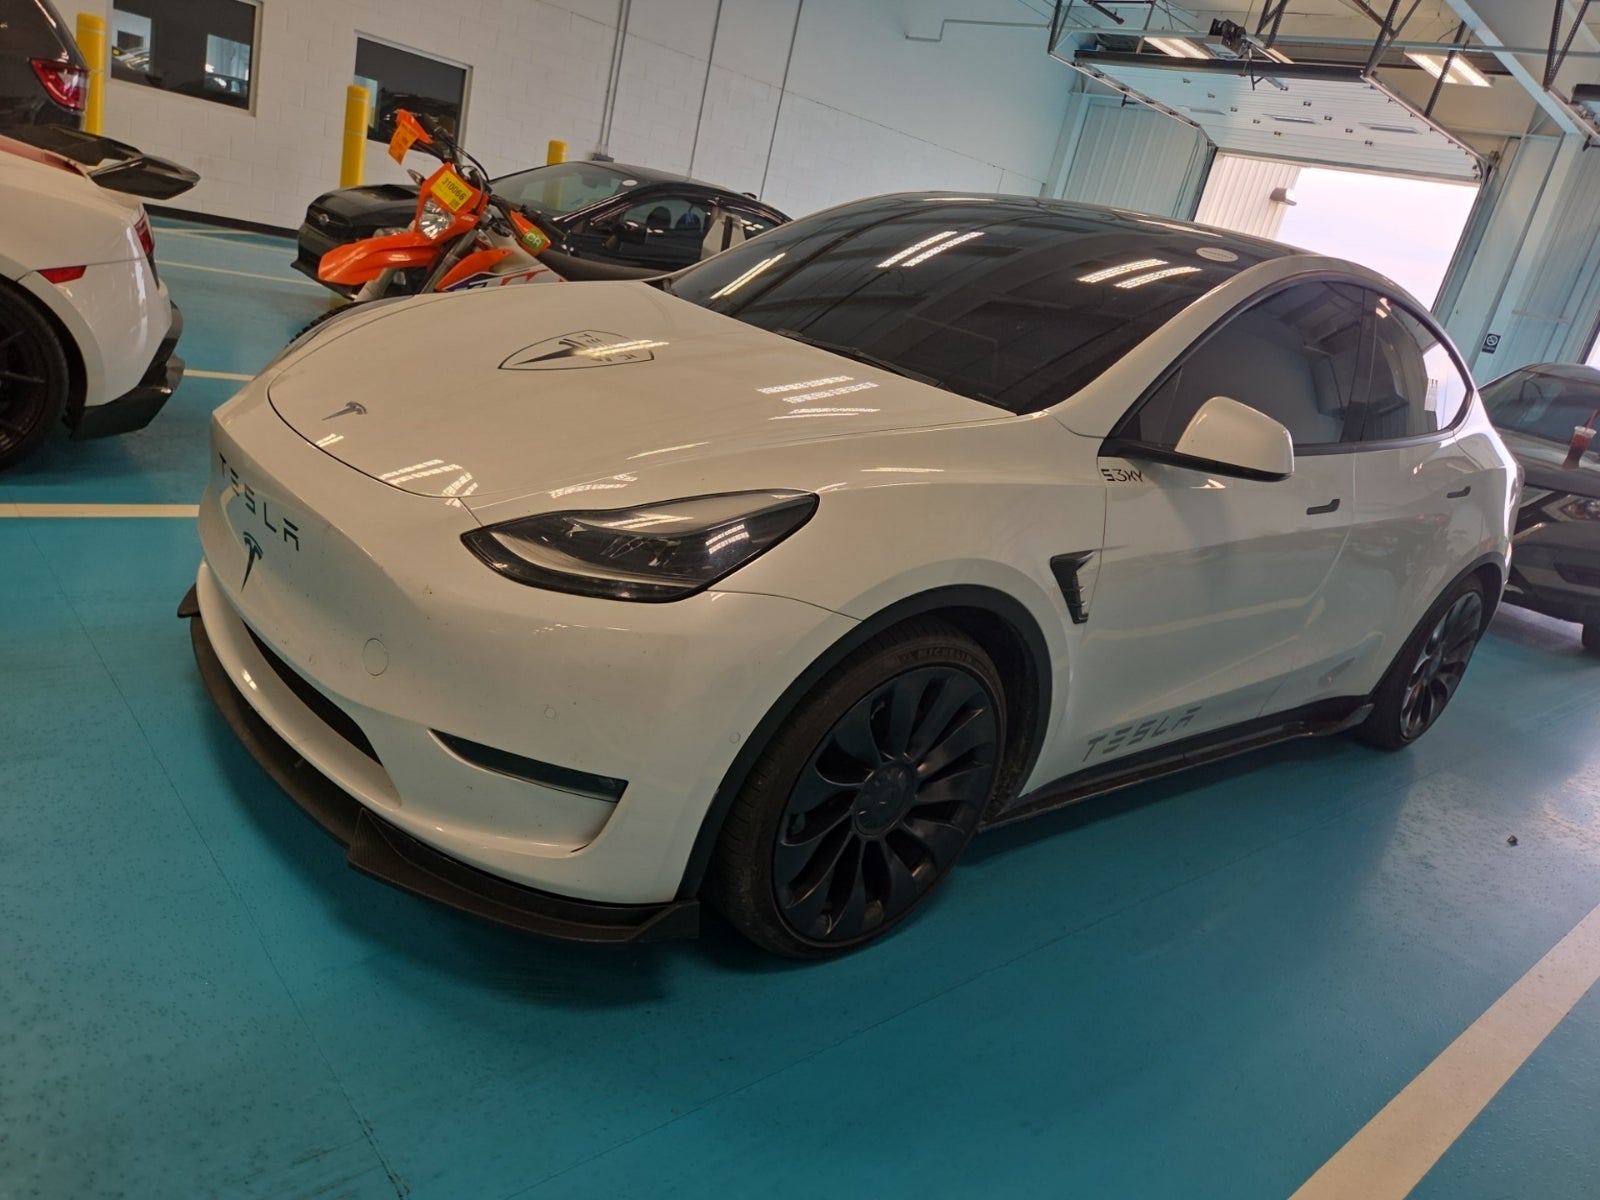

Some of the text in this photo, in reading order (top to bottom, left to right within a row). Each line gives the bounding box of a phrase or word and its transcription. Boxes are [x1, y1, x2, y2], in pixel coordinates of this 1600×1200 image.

[219, 451, 299, 551] TESLA
[1100, 468, 1144, 483] S3XY
[1082, 705, 1202, 762] TESLA
